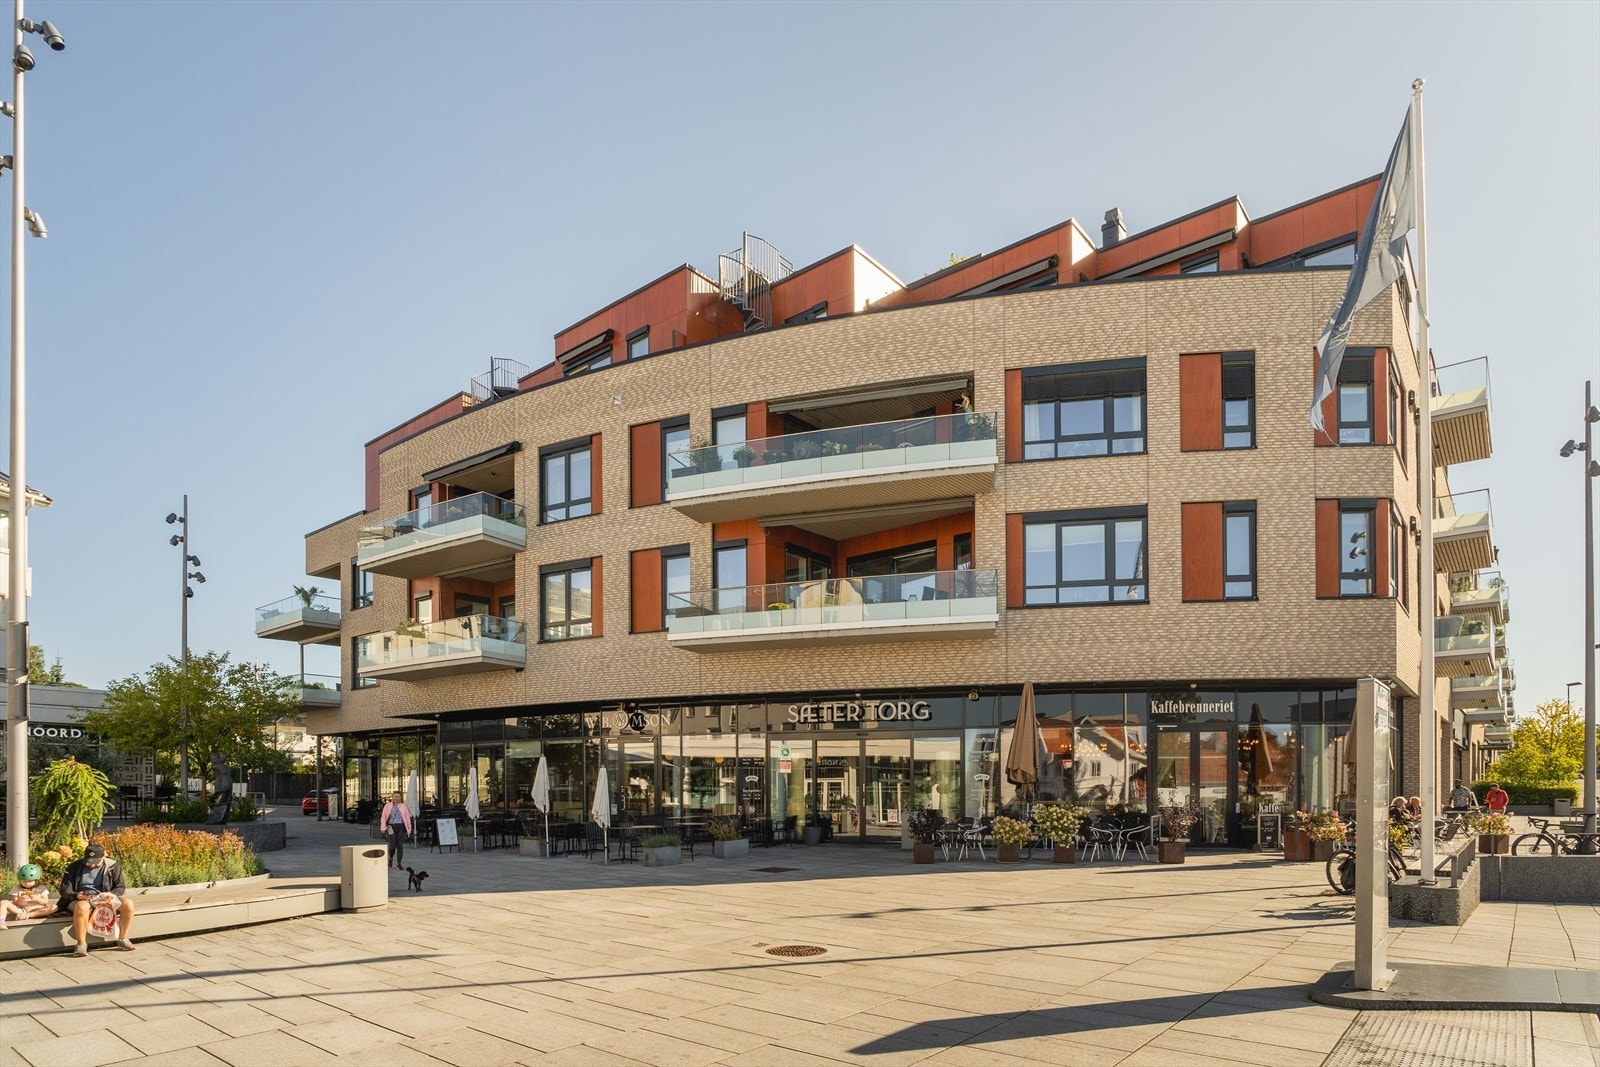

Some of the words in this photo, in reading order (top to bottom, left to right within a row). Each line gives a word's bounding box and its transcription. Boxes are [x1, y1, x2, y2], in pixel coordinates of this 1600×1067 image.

[787, 704, 860, 723] SÆTER
[866, 700, 930, 721] TORG
[1151, 700, 1234, 714] Kaffebrenneriet
[1258, 802, 1279, 813] Kaffe
